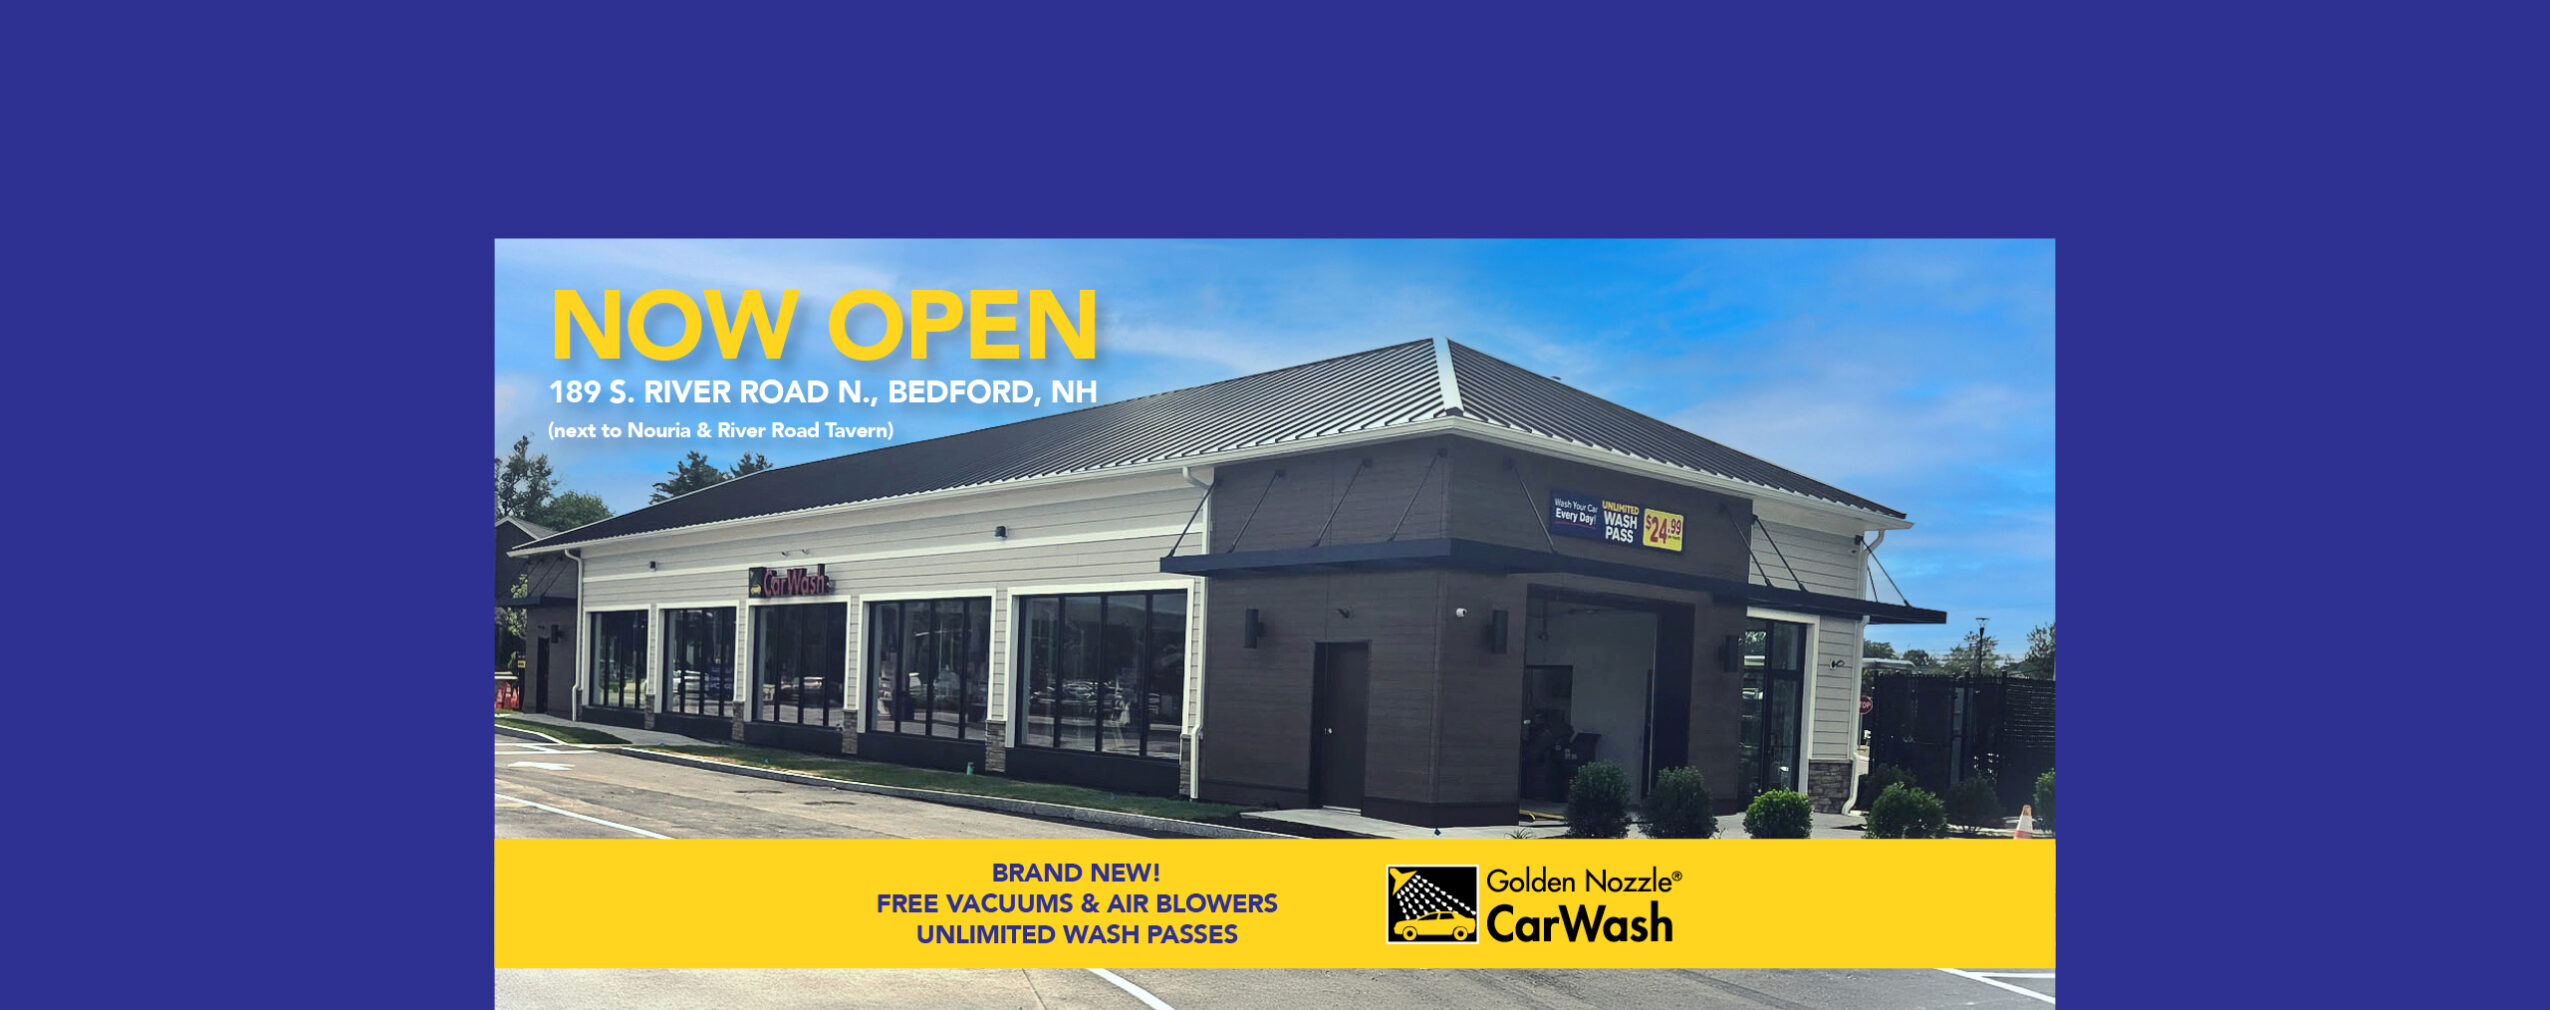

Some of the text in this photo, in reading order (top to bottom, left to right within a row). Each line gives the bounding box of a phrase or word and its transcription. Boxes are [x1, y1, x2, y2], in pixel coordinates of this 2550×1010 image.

[1554, 498, 1598, 513] Wash Your Car
[1602, 500, 1640, 516] UNLIMITED
[1555, 508, 1597, 526] Every Day!
[1604, 511, 1638, 529] WASH
[1605, 526, 1634, 543] PASS
[1646, 514, 1681, 544] $24.99
[764, 564, 826, 597] CarWash
